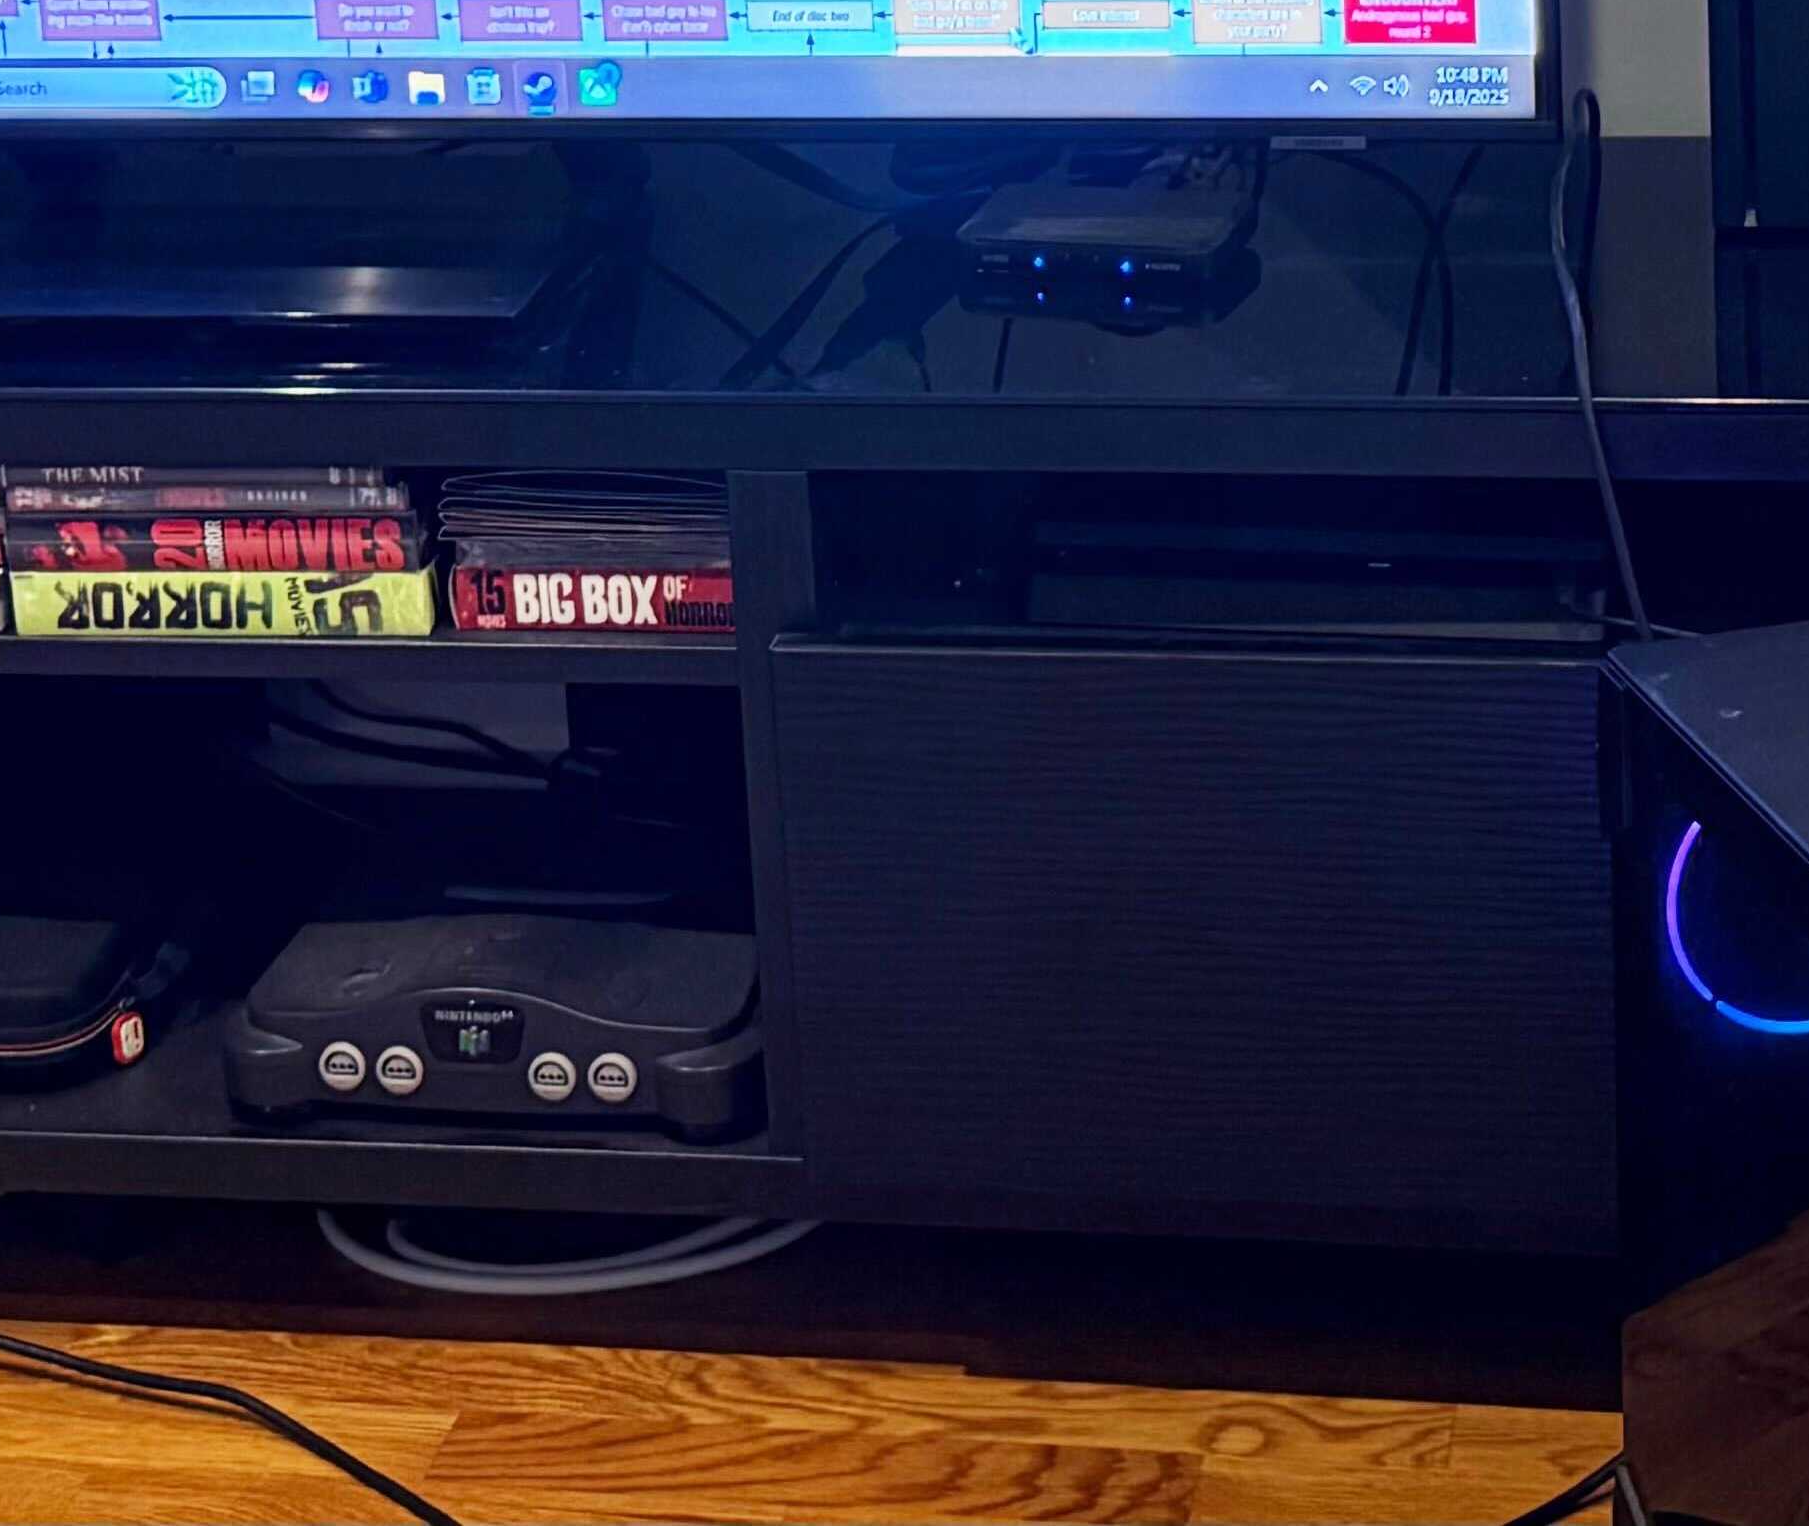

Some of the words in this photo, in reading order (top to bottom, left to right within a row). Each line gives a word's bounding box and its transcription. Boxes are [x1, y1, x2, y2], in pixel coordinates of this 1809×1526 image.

[44, 468, 86, 482] THE
[92, 468, 144, 482] MIST
[152, 519, 207, 570] 20
[226, 519, 405, 571] MOVIES
[470, 571, 505, 614] 15
[513, 574, 576, 624] BIG
[581, 574, 658, 625] BOX
[663, 575, 689, 601] OF
